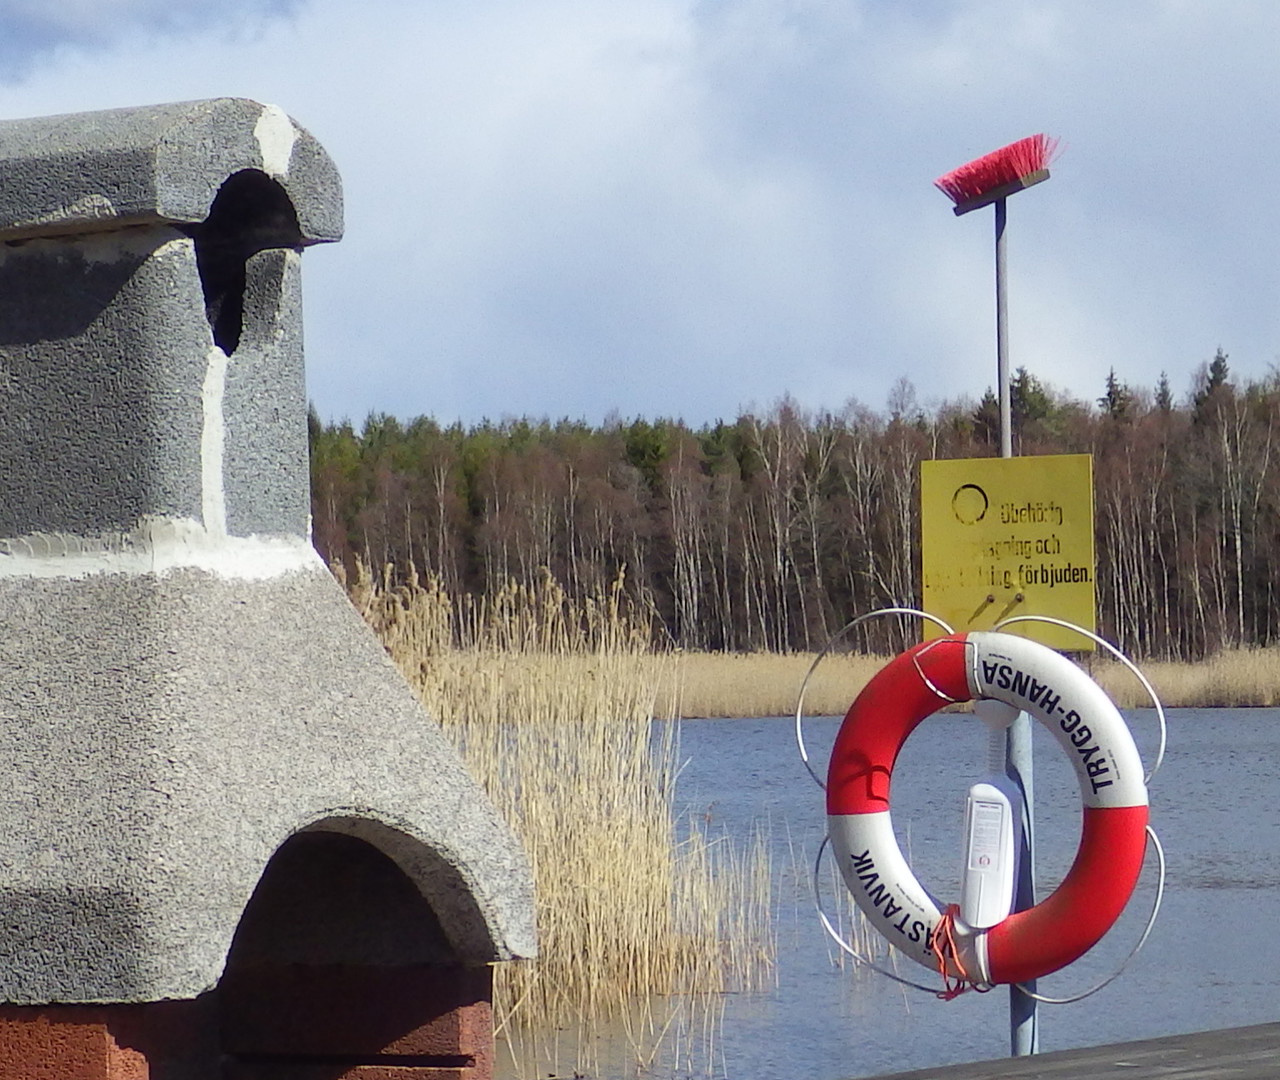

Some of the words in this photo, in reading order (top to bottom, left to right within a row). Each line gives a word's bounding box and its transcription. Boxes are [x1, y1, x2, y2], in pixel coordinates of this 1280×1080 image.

[1035, 533, 1061, 555] och
[1018, 562, 1093, 589] förbjuden.
[982, 660, 1114, 795] TRYGG-HANSA
